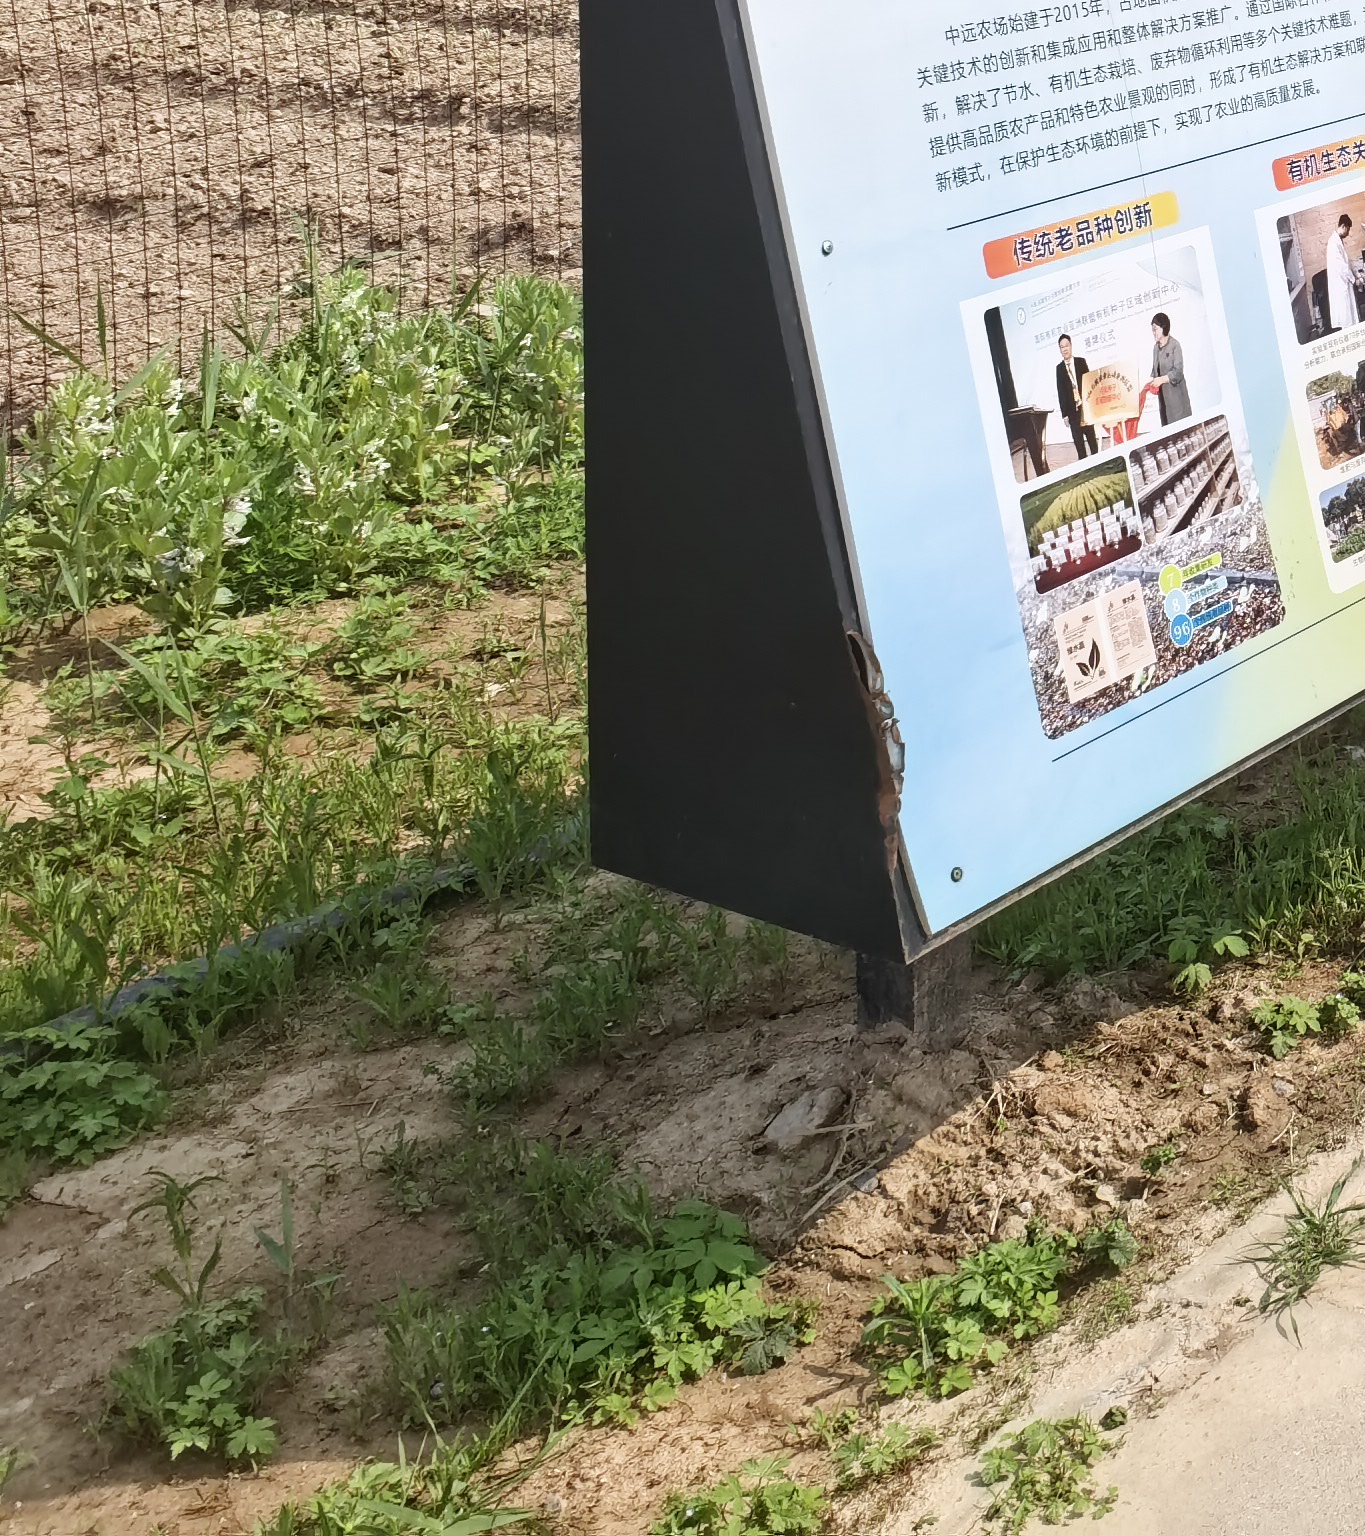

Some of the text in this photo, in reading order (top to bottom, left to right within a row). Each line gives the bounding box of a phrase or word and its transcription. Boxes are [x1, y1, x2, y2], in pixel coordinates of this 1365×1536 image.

[1013, 201, 1153, 267] 传统老品种创新
[1171, 597, 1180, 612] 8
[1173, 618, 1190, 640] 96
